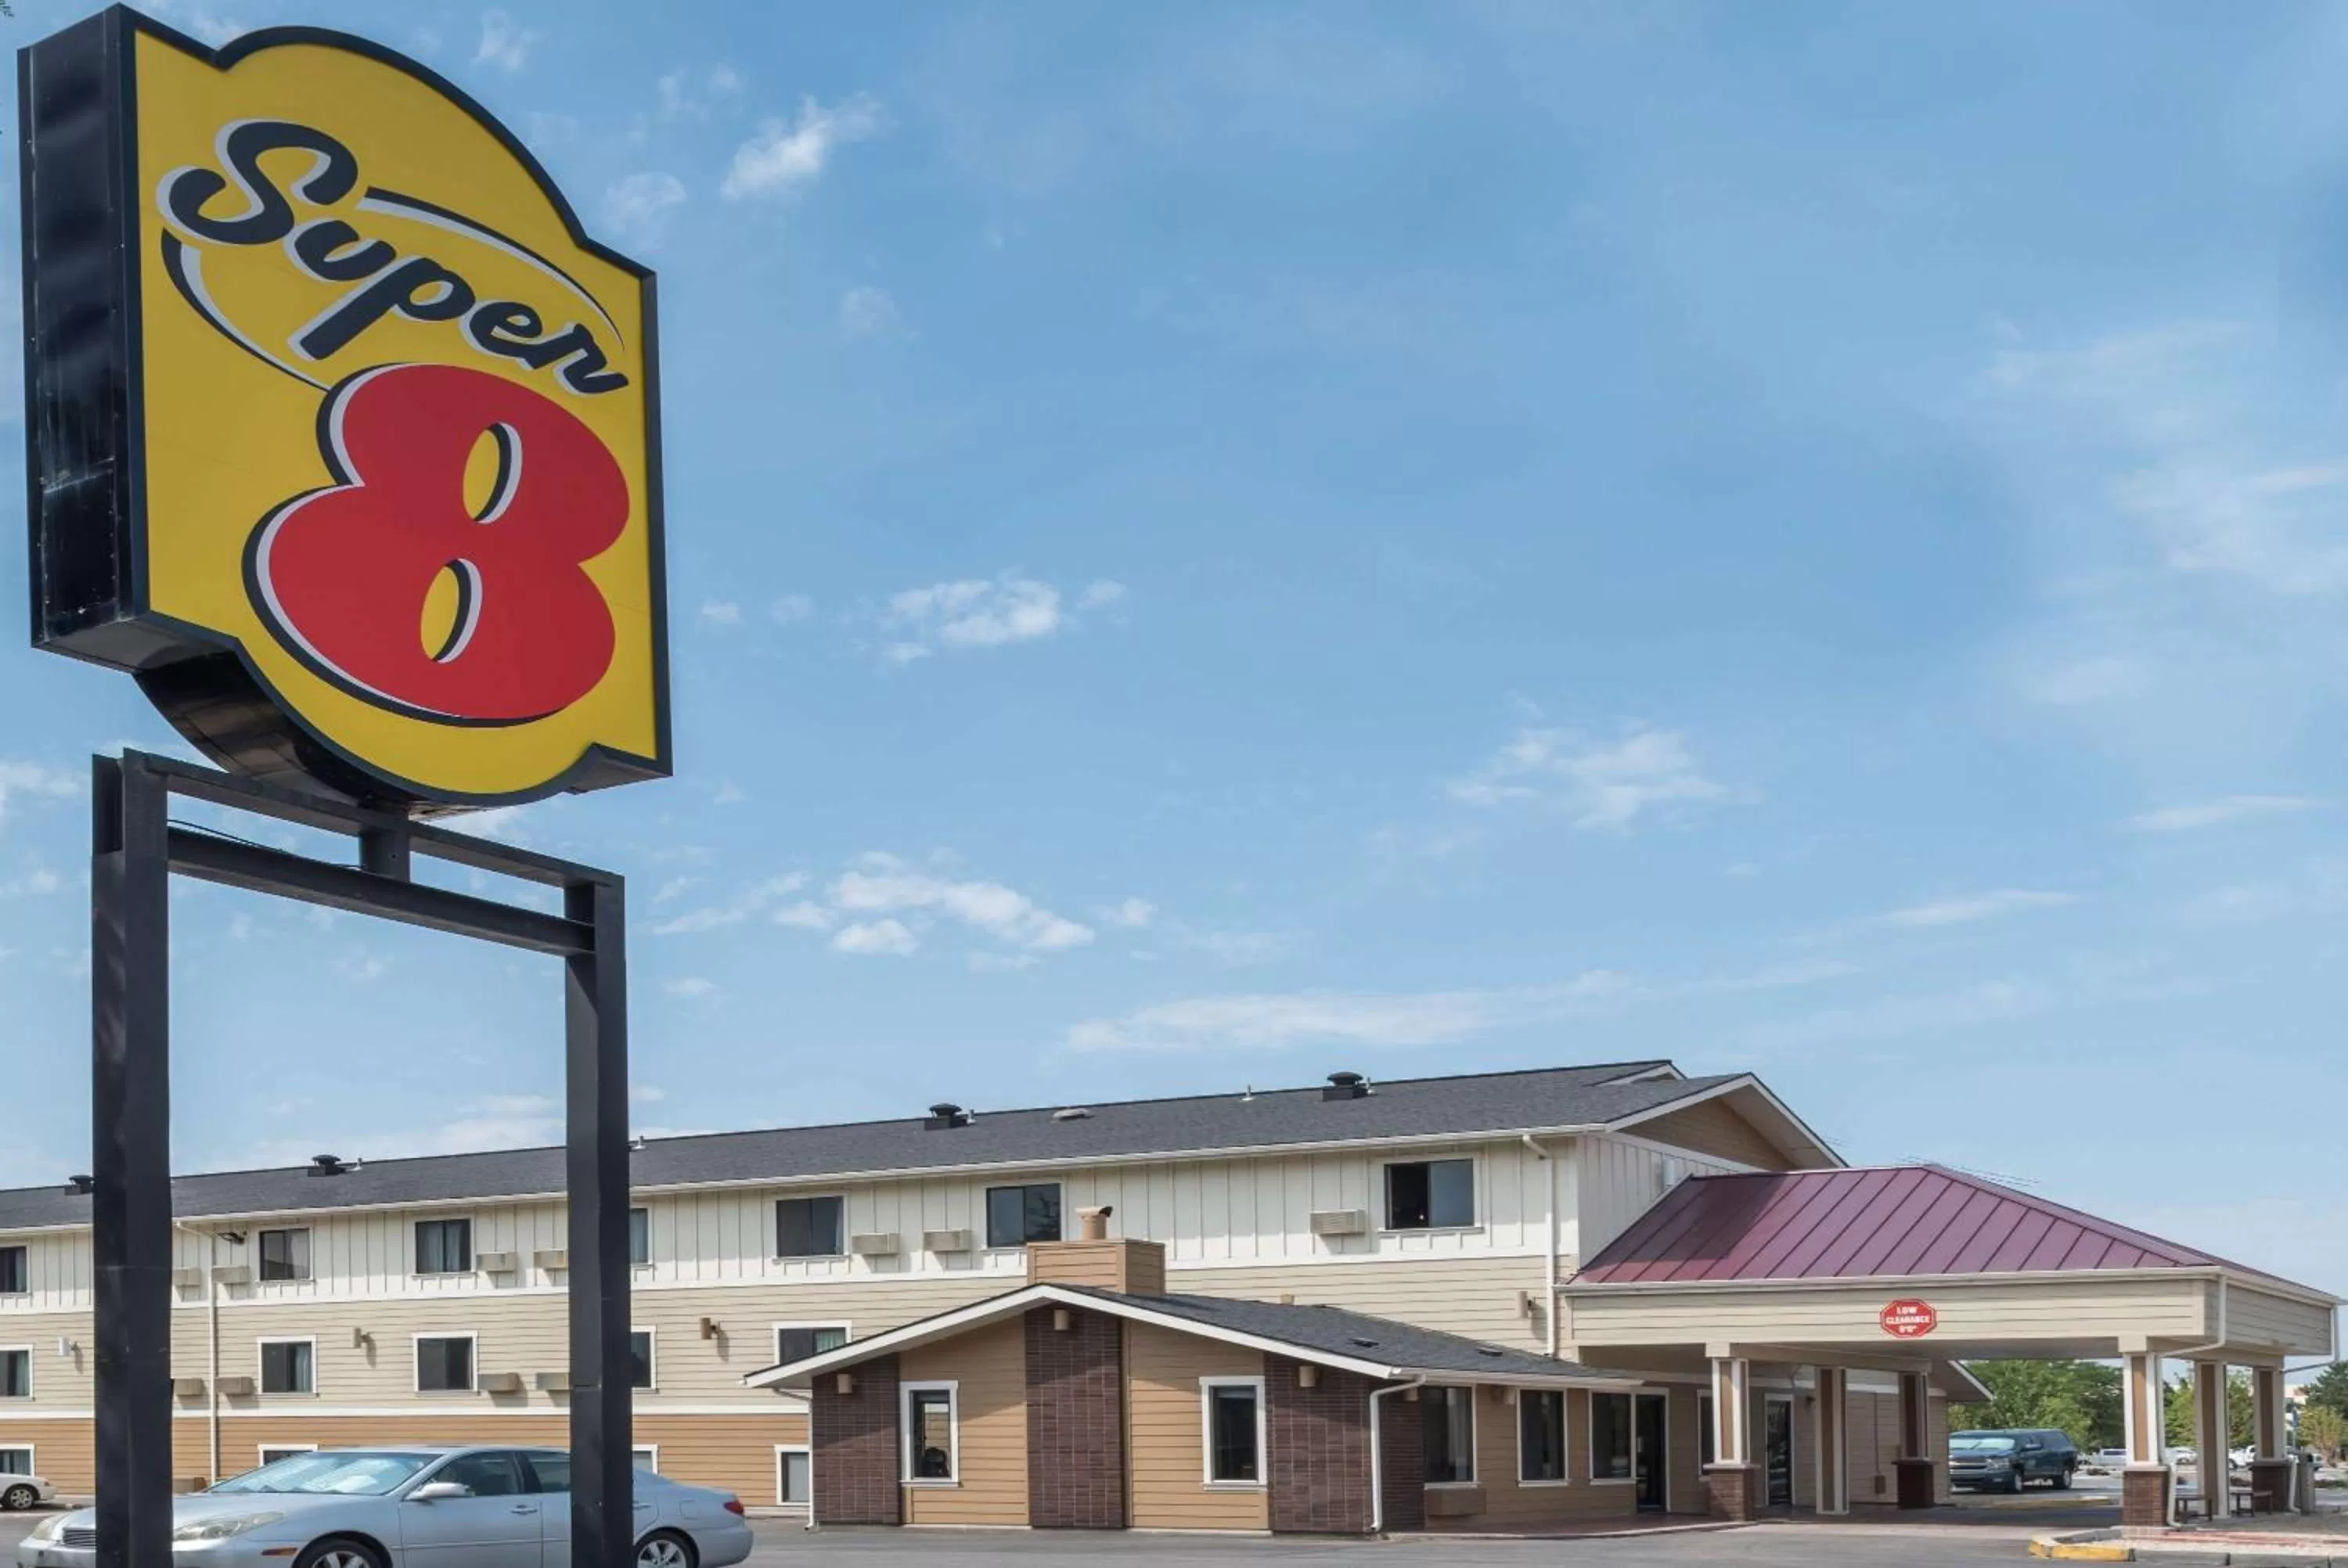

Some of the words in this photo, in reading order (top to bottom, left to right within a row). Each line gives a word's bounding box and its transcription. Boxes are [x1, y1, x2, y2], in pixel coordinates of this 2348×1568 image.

[157, 119, 628, 394] Super
[241, 362, 630, 728] 8
[1885, 1315, 1930, 1325] CLEARANCE
[1896, 1306, 1918, 1314] LOW
